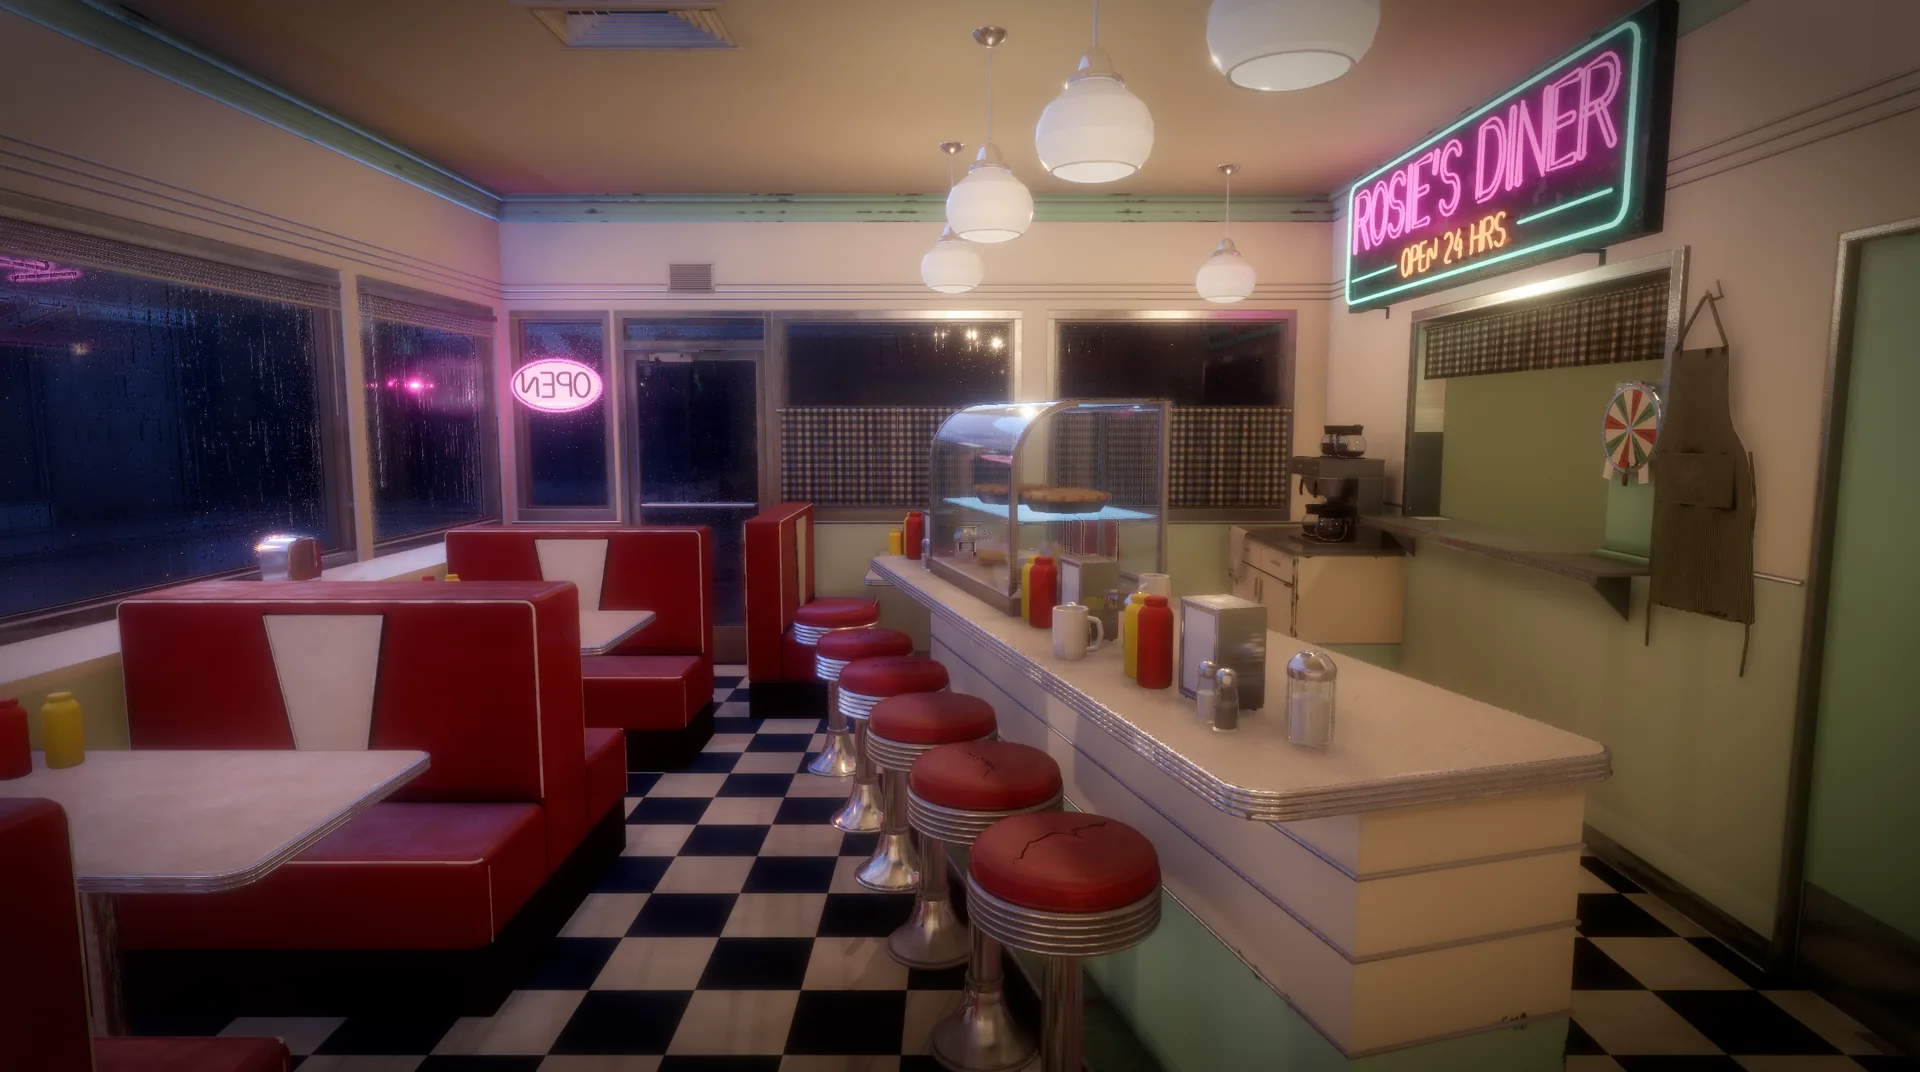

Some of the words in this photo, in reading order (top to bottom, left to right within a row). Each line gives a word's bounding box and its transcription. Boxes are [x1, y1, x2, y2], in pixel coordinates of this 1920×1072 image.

[1352, 139, 1463, 256] ROSIE'S
[1475, 50, 1621, 204] DINER
[1400, 237, 1439, 278] OPEN
[1443, 228, 1464, 265] 24
[1468, 211, 1507, 256] HRS
